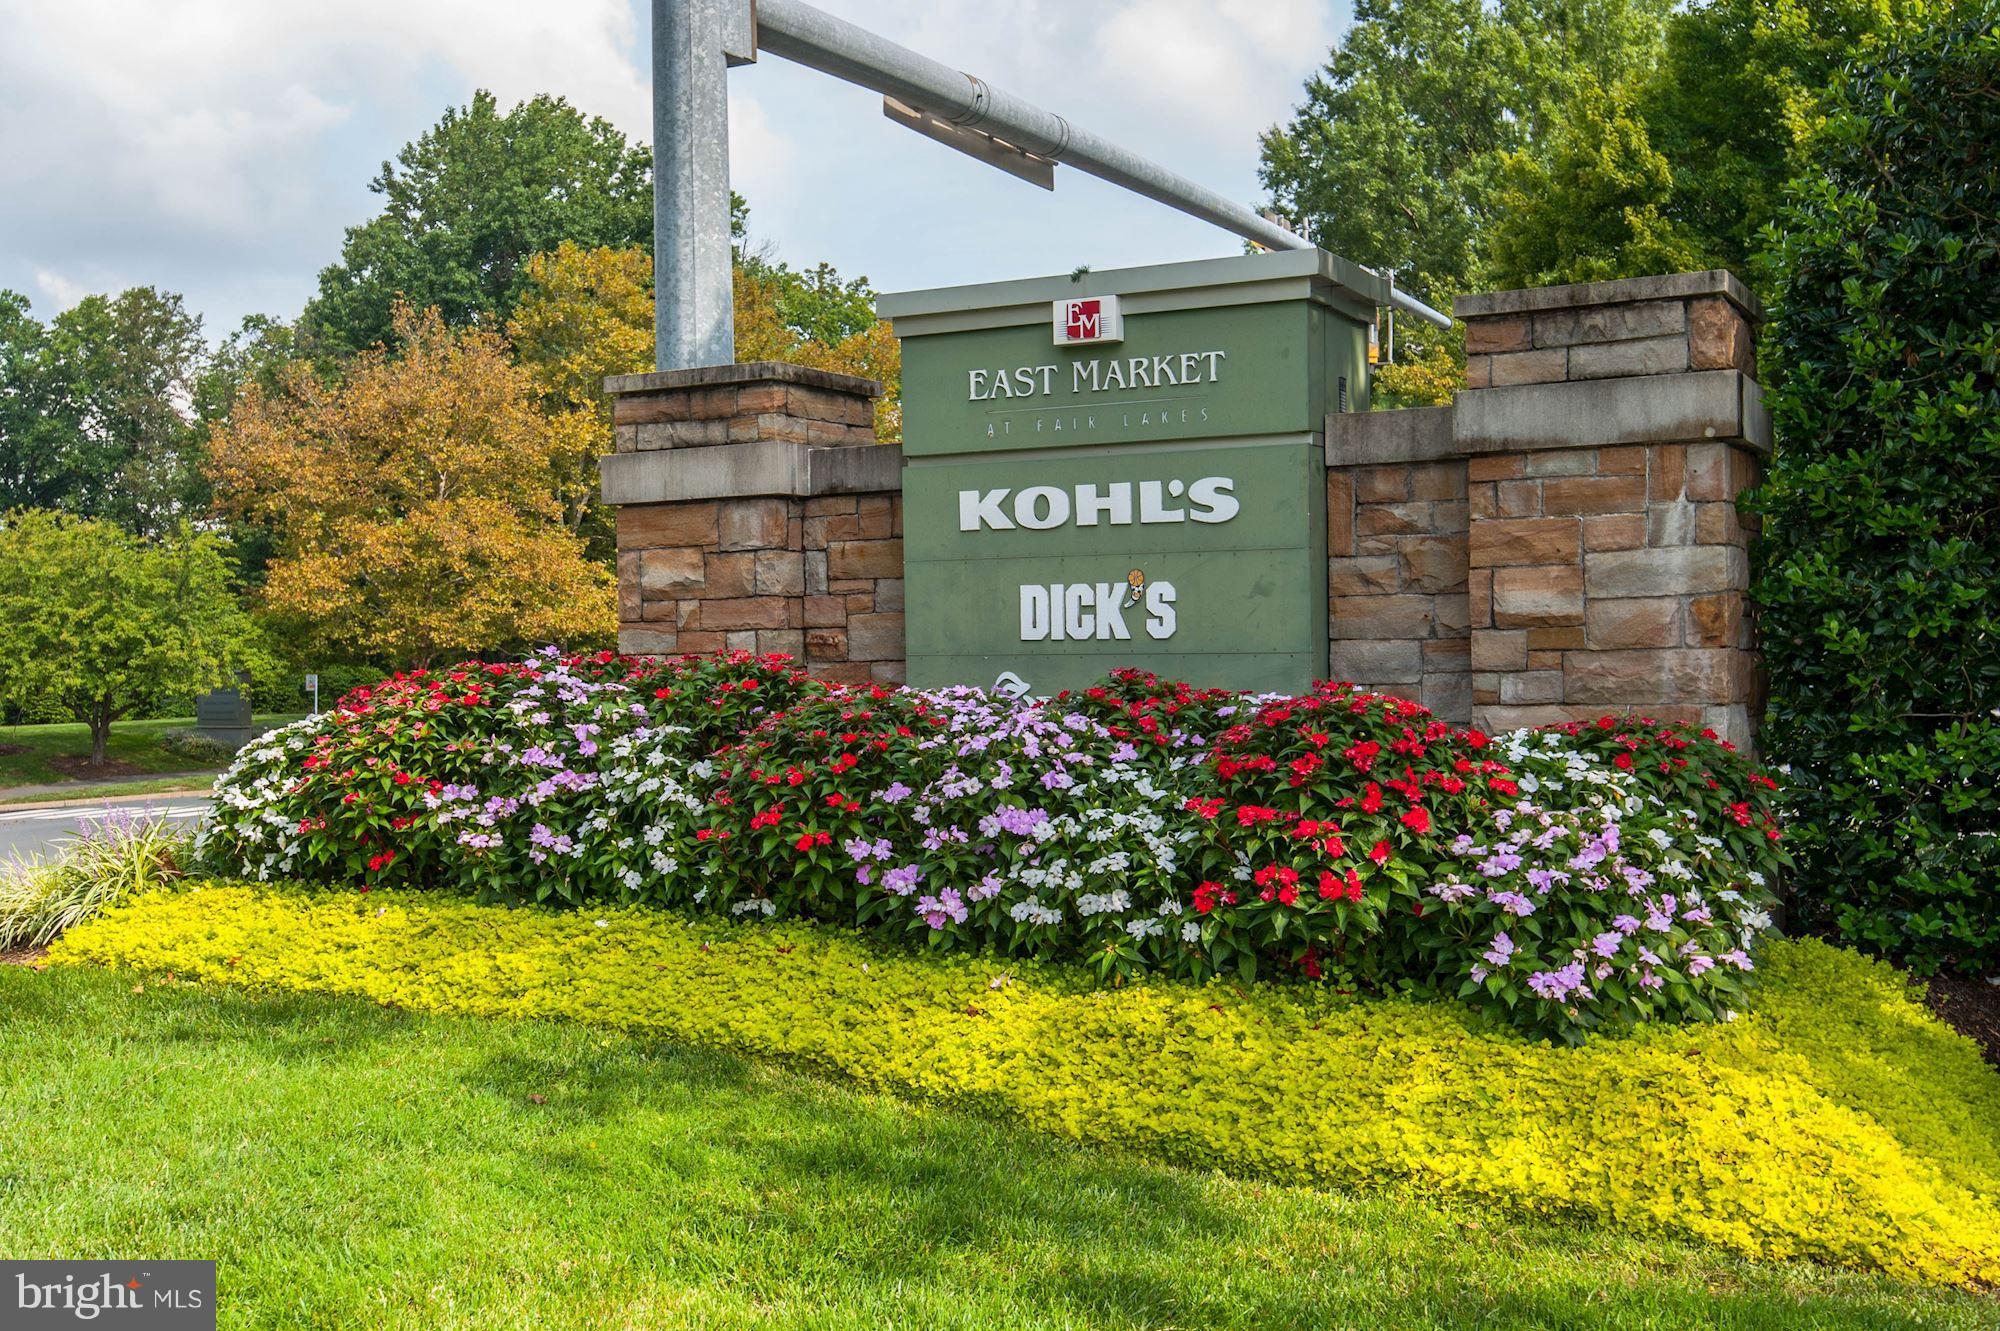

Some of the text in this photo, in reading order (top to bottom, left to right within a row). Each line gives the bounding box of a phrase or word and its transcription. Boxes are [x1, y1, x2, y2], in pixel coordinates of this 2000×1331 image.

[968, 350, 1226, 401] EAST MARKET
[987, 407, 1209, 438] AT FAIR LAKES
[959, 476, 1240, 532] KOHL'S
[1020, 568, 1178, 642] DICK'S
